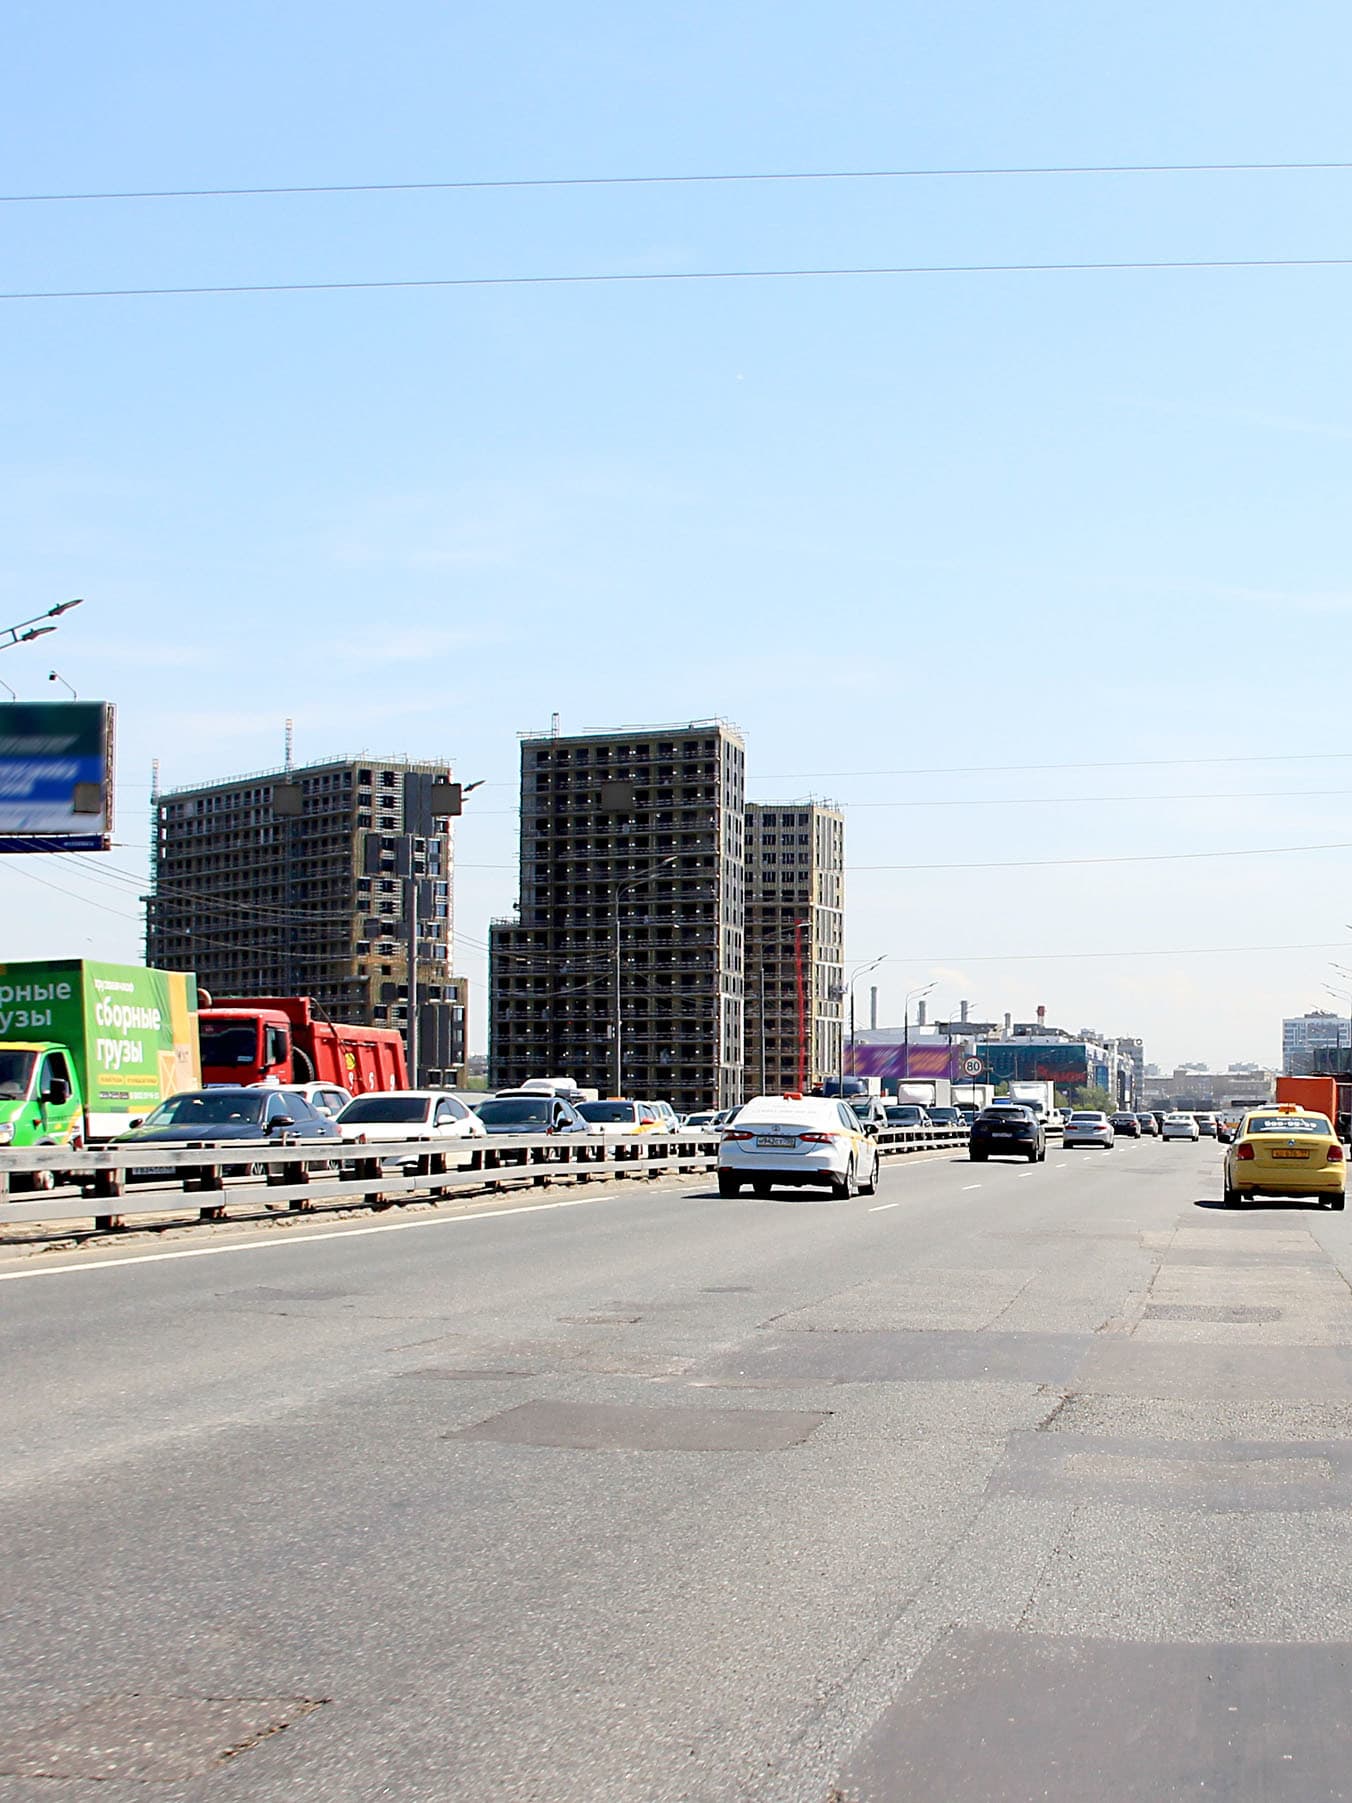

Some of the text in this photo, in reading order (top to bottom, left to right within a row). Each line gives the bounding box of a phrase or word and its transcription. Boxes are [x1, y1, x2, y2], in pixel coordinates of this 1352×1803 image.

[0, 982, 72, 1009] рные
[95, 996, 161, 1036] сборные
[96, 1038, 144, 1071] грузы
[966, 1060, 980, 1072] 80
